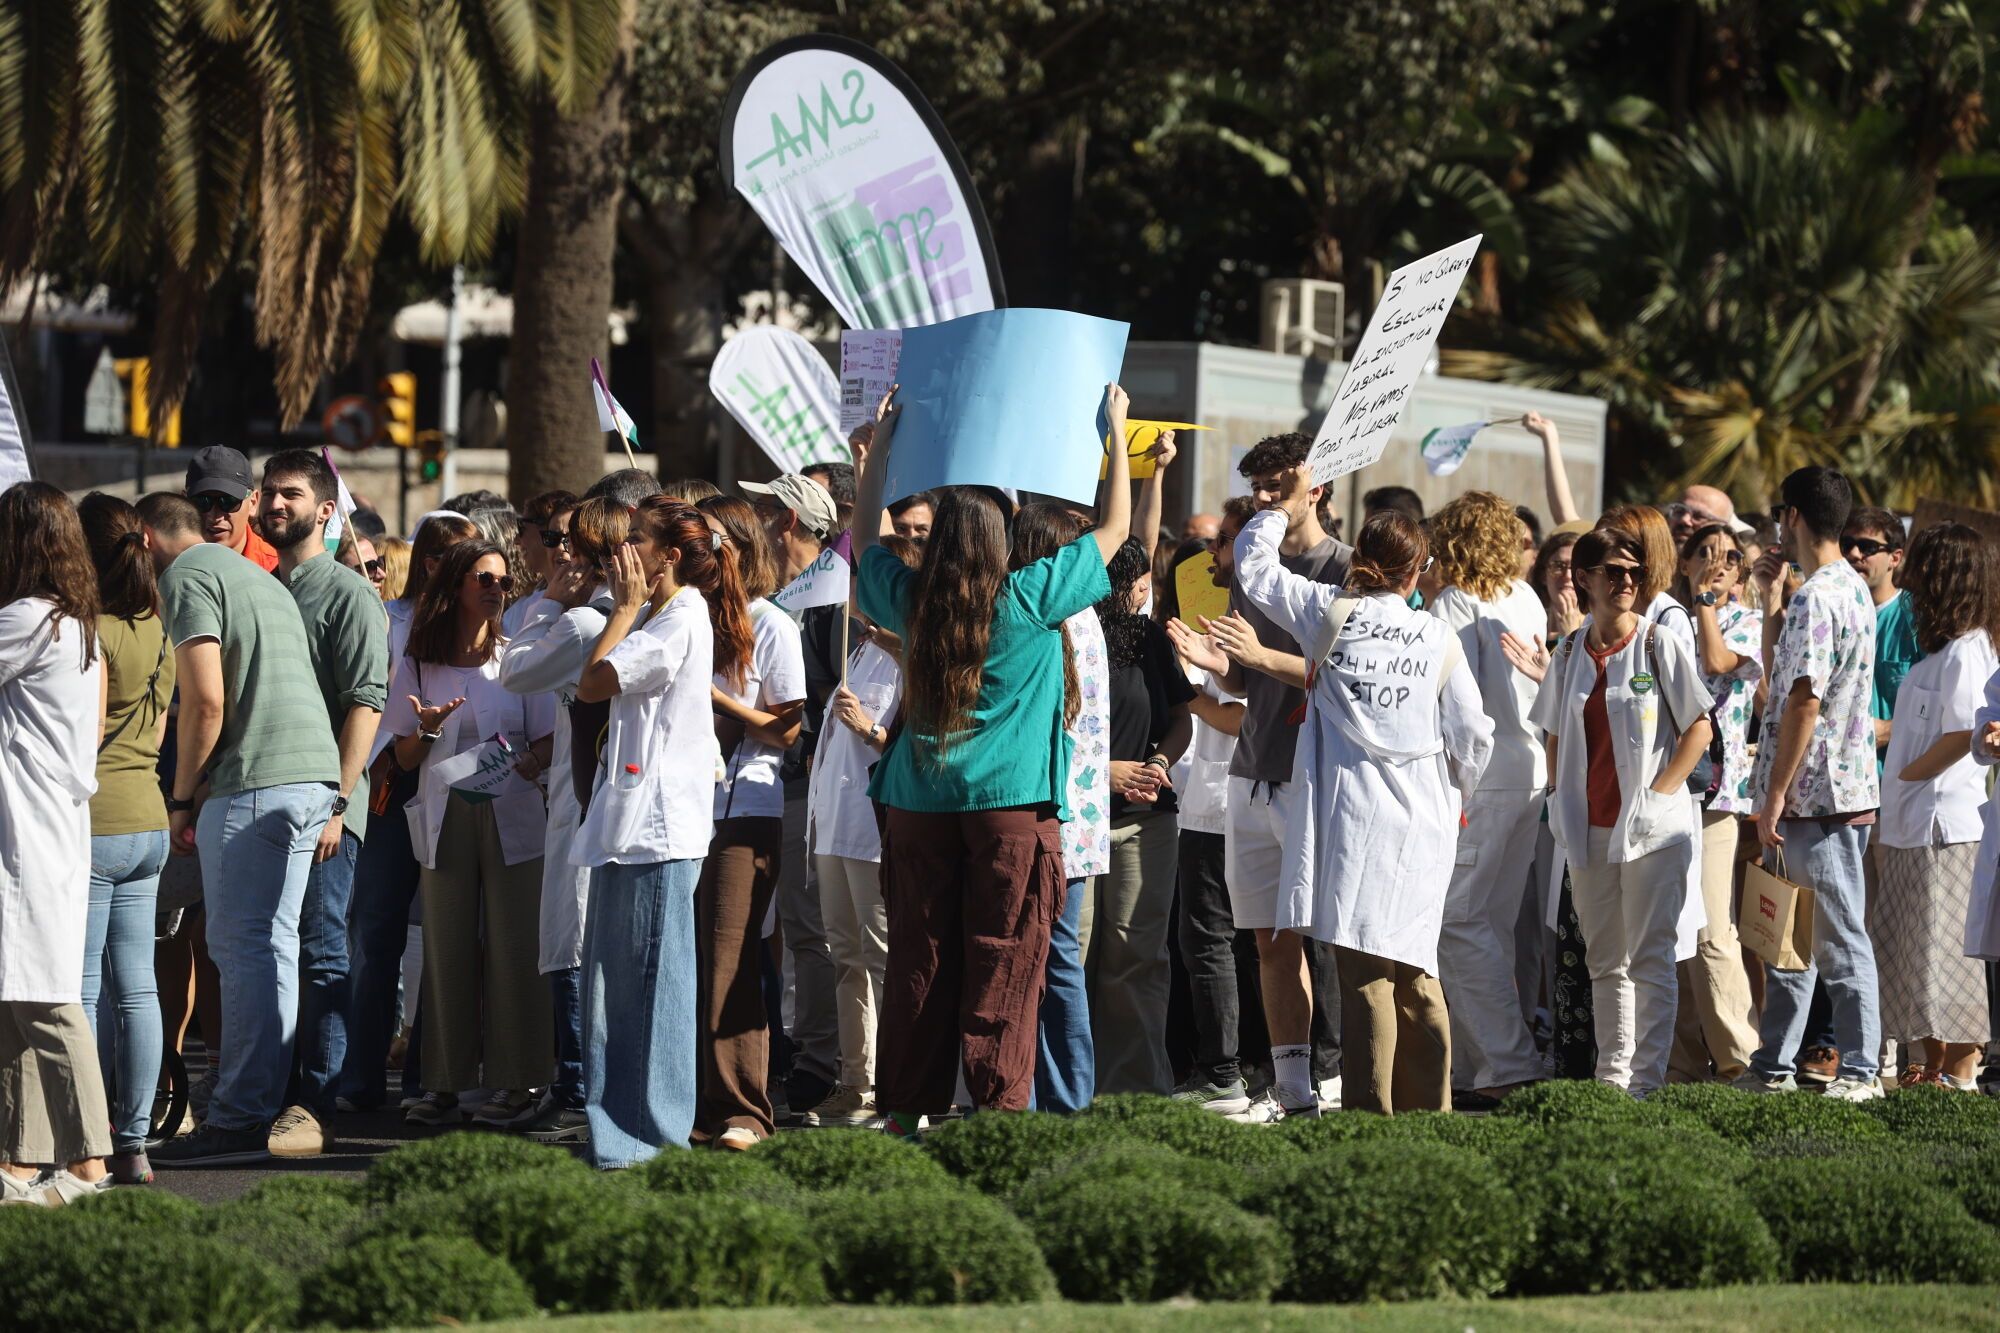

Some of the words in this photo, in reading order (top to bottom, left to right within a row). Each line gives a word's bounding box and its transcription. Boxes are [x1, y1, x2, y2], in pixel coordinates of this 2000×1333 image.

[1416, 272, 1433, 288] NO
[1382, 297, 1445, 332] ESCUCHAR
[1353, 349, 1368, 372] LA
[1341, 361, 1397, 401] LABORAL
[1339, 396, 1369, 430] NOS
[1370, 384, 1408, 414] VAMOS
[1313, 437, 1343, 461] TODOS
[1347, 423, 1360, 445] A
[1341, 610, 1424, 648] ESCLAVA
[1386, 656, 1428, 677] NON
[1347, 681, 1410, 710] STOP
